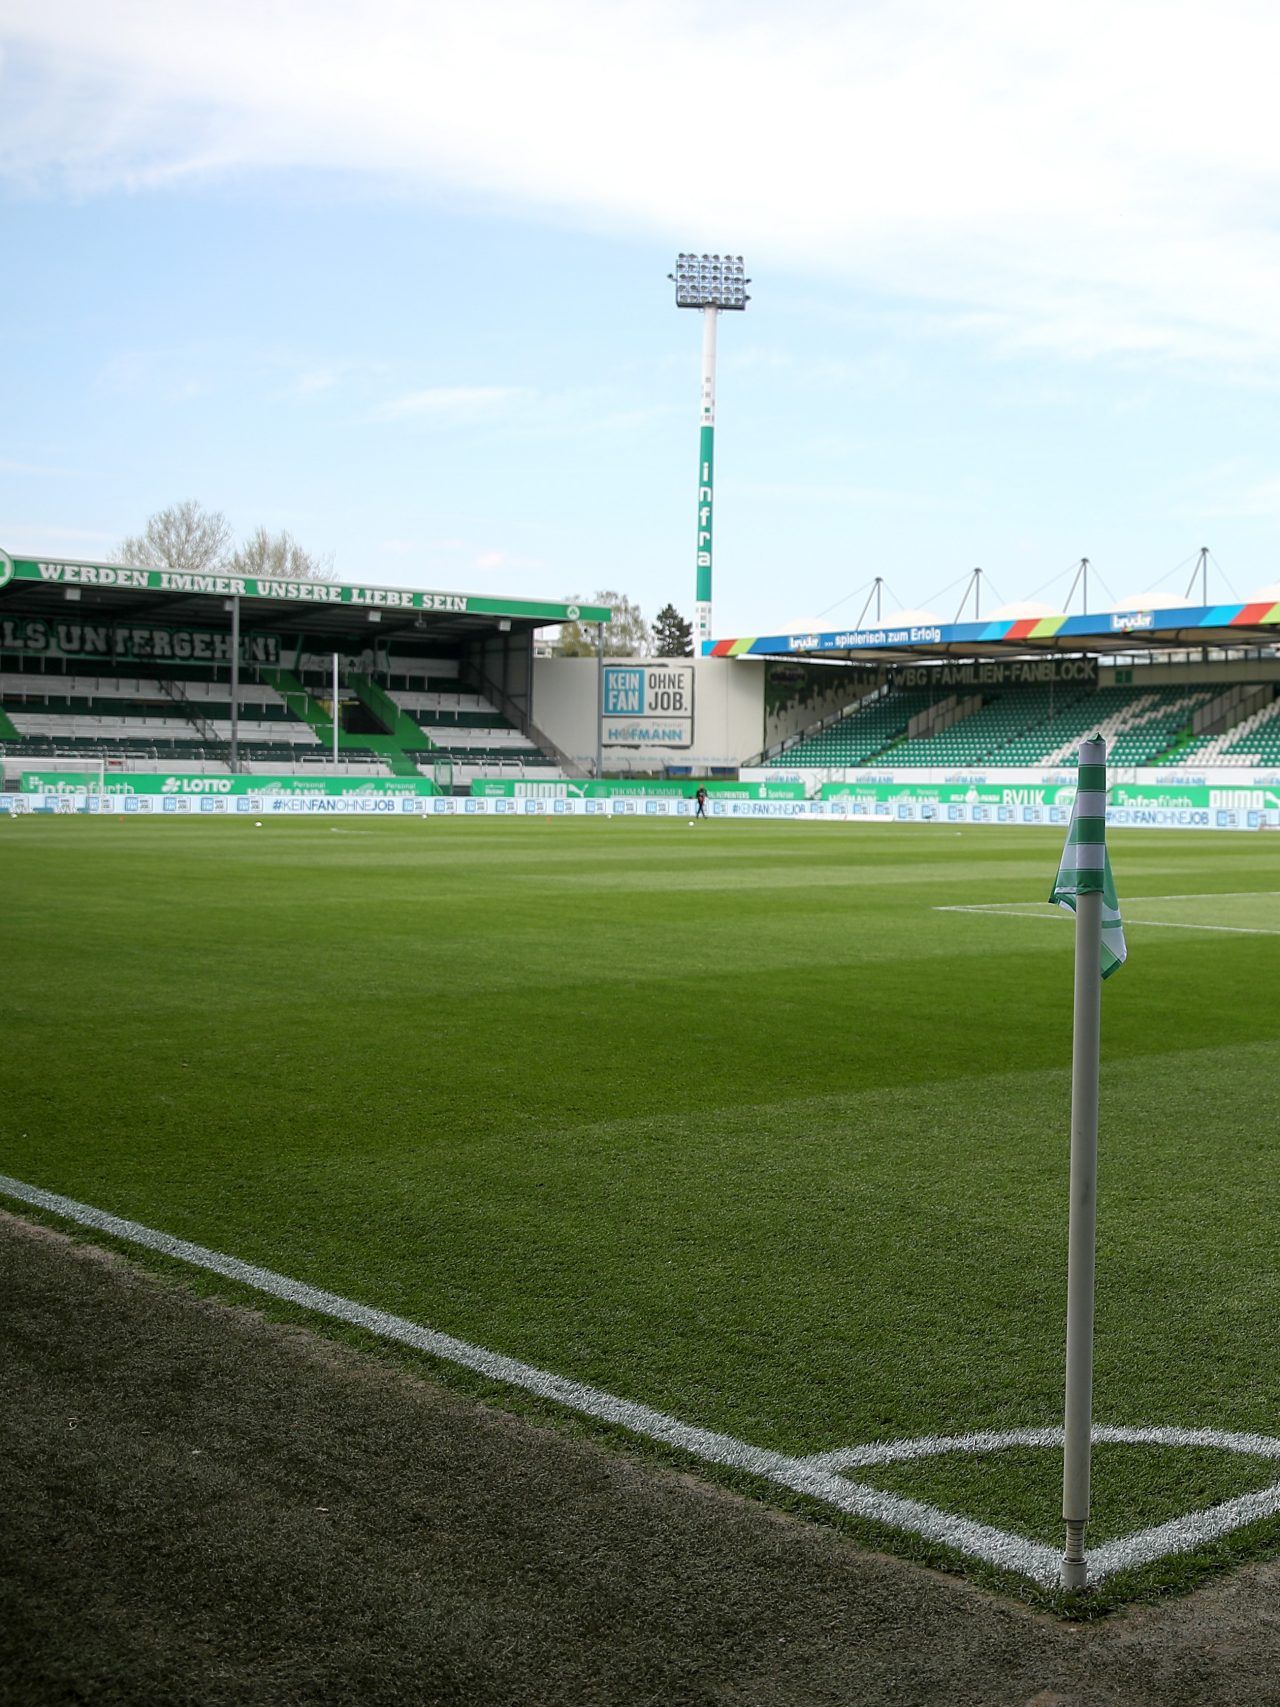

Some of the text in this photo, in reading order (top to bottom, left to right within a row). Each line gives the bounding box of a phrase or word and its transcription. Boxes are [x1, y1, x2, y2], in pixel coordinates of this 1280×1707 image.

[697, 463, 712, 567] infra
[38, 563, 467, 611] WERDEN IMMER UNSERE LIEBE SEIN
[58, 625, 276, 663] UNTERGEHN!
[888, 630, 909, 643] zum
[910, 627, 942, 643] Erfolg
[608, 672, 640, 690] KEIN
[648, 673, 685, 690] OHNE
[893, 659, 1096, 686] WBG FAMILIEN-FANBLOCK
[608, 690, 640, 711] FAN
[648, 691, 688, 711] JOB.
[182, 779, 232, 793] LOTTO
[272, 798, 395, 813] #KEINFANOHNEJOB
